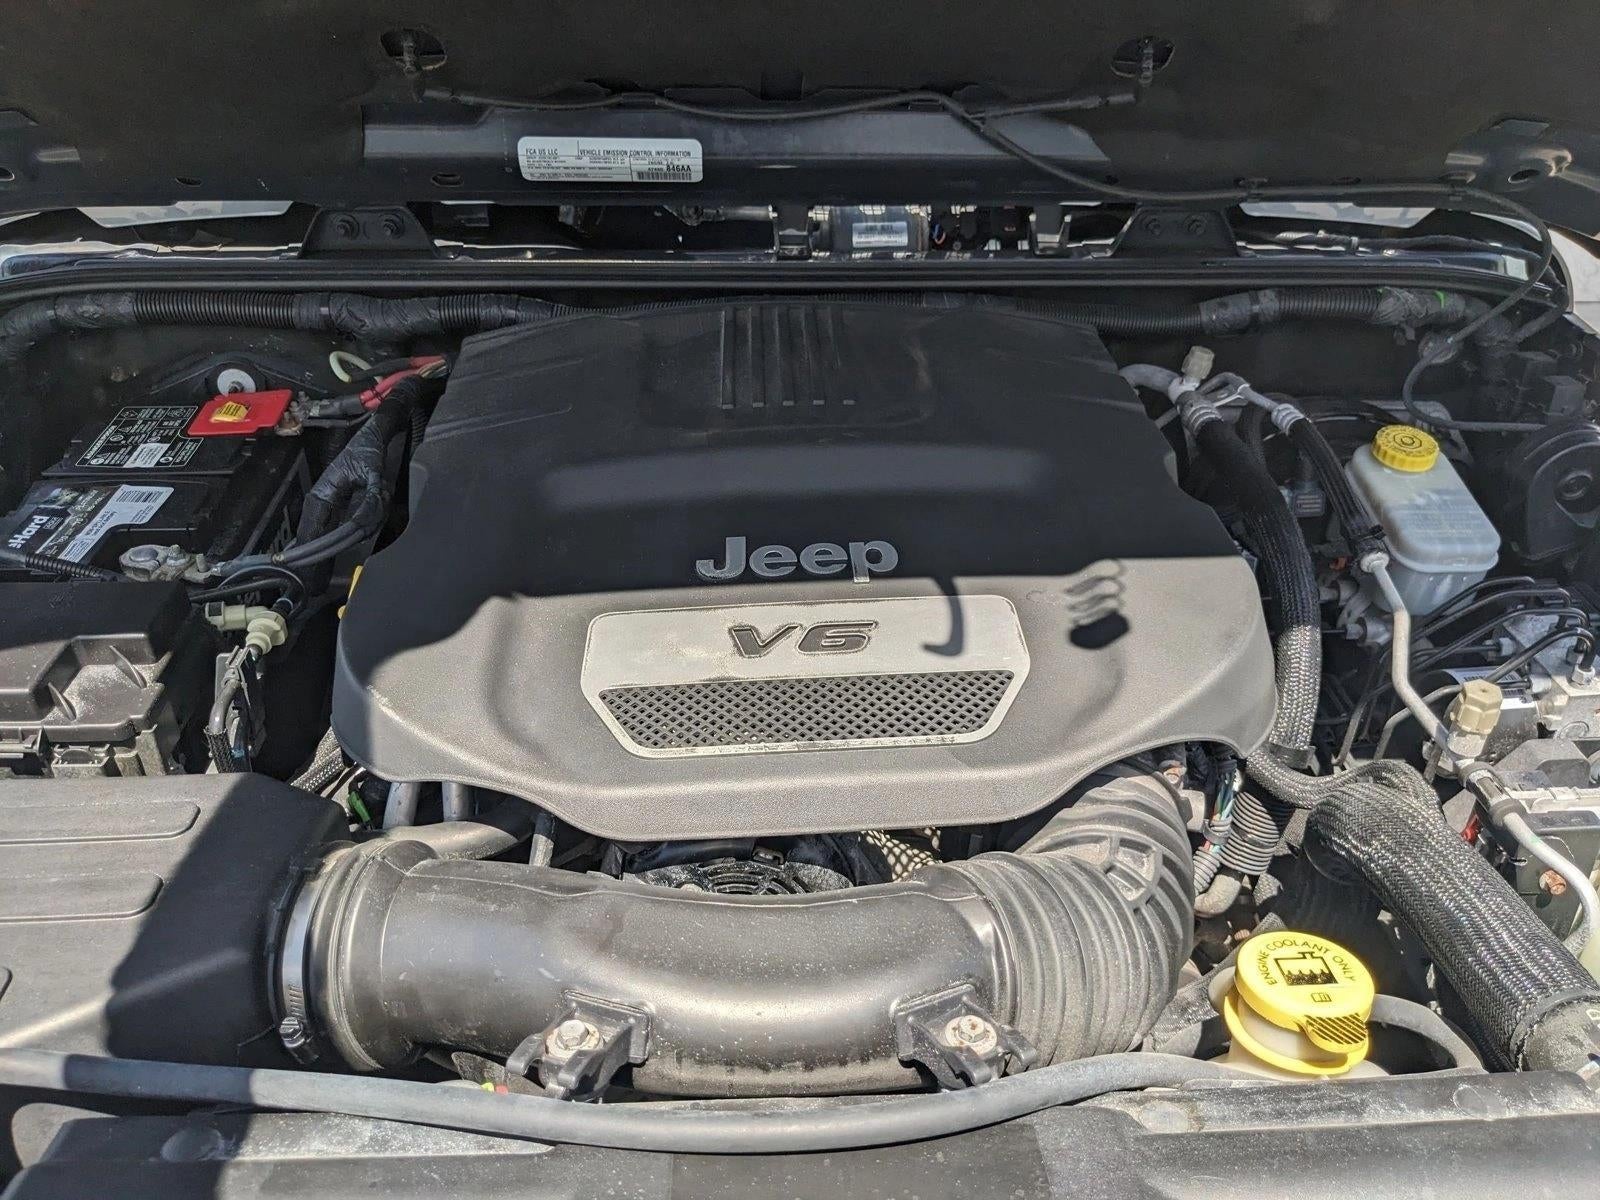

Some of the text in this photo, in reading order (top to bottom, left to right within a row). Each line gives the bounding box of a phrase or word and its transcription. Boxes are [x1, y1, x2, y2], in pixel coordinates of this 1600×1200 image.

[525, 148, 558, 156] FCA US LLC
[579, 149, 692, 158] VEHICLE EMISSION CONTROL INFORMATION
[666, 164, 692, 173] 846AA
[695, 535, 899, 584] Jeep
[729, 620, 878, 659] V6
[1256, 938, 1356, 986] ENGINE COOLANT ONLY
